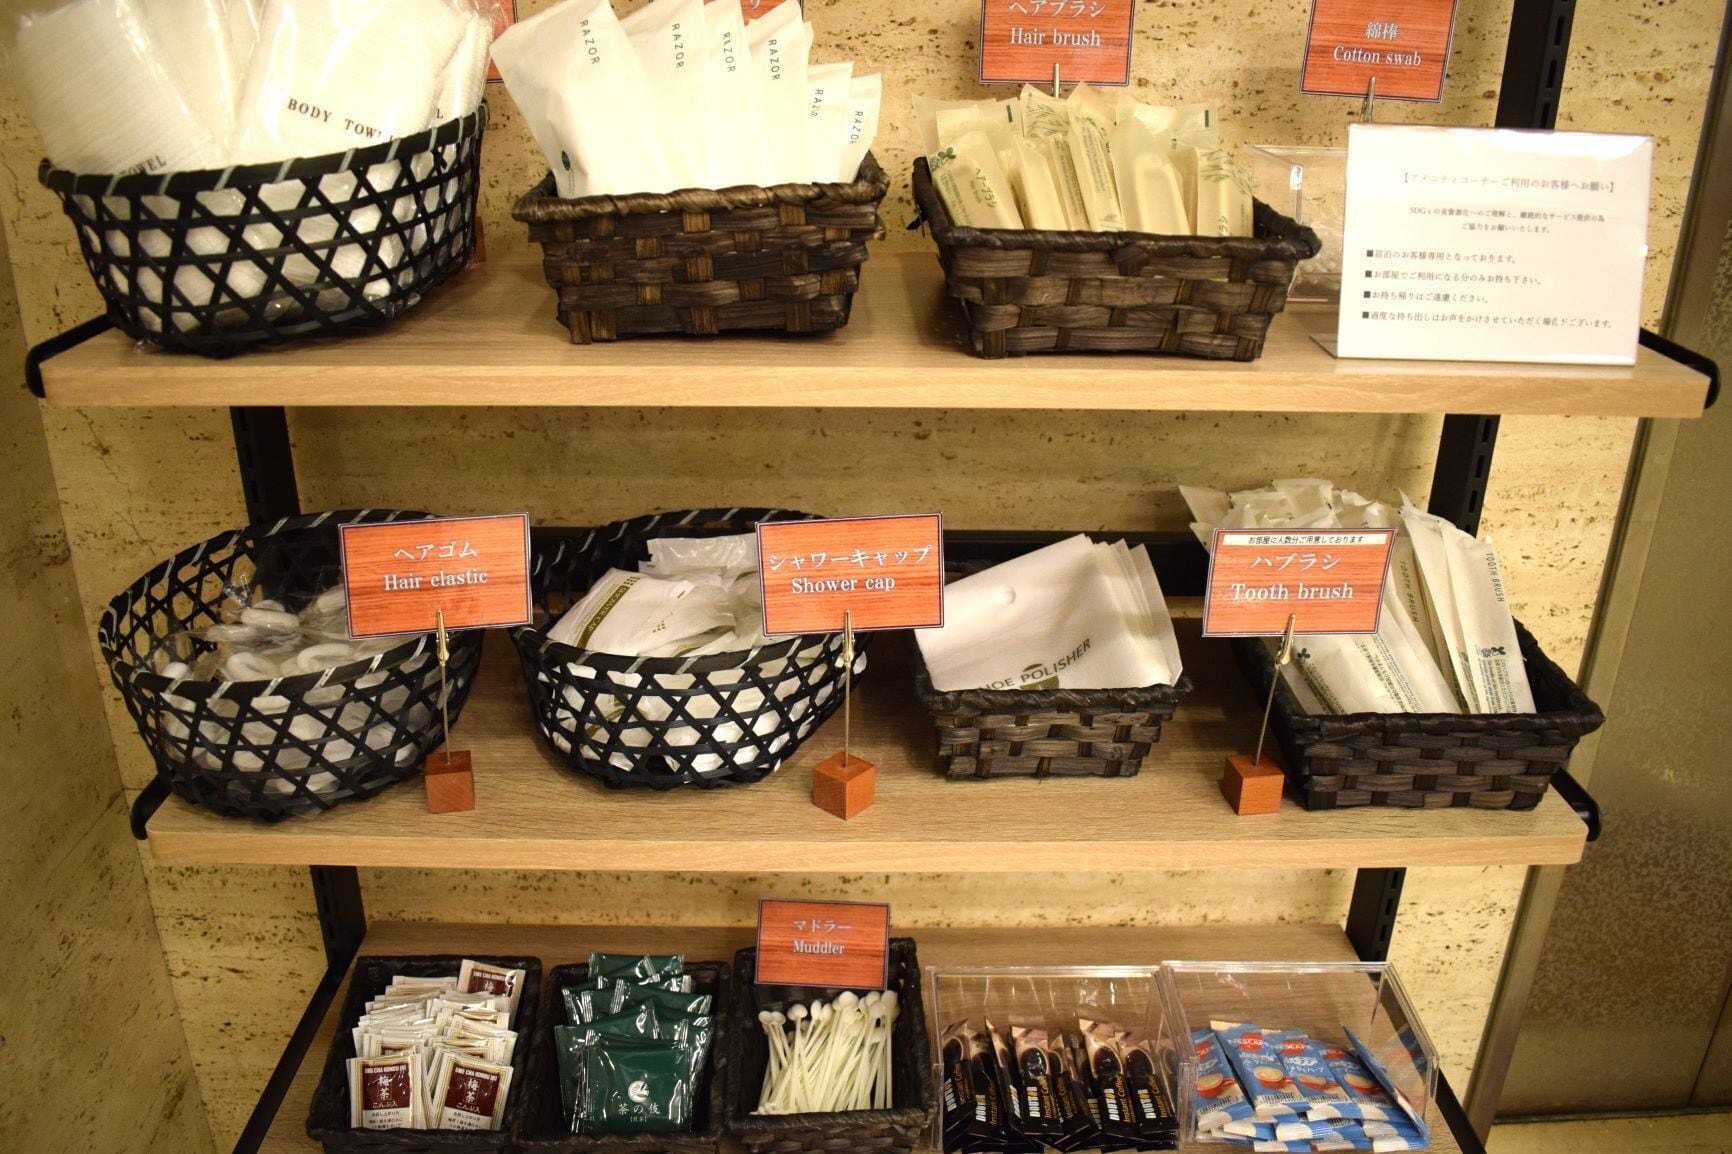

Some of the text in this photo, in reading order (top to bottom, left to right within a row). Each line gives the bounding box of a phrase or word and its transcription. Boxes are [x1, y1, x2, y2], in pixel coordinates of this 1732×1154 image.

[1008, 0, 1105, 17] ヘアブラシ
[579, 19, 600, 65] RAZOR
[1010, 27, 1101, 46] Hair brush
[1365, 21, 1398, 40] 綿棒
[671, 23, 685, 69] RAZOR
[1333, 45, 1422, 66] Cotton swab
[768, 39, 780, 81] RAZOR
[288, 97, 333, 123] BODY
[393, 540, 478, 560] ヘアゴム
[768, 544, 933, 571] シャワーキャップ
[1249, 553, 1343, 572] ハブラシ
[384, 569, 489, 591] Hair elastic
[792, 577, 896, 594] Shower cap
[1485, 552, 1505, 602] TOOTH BRUSH
[1231, 582, 1354, 602] Tooth brush
[1400, 560, 1420, 623] TOOTH BRUSH
[1020, 638, 1091, 683] POLISHER
[793, 919, 853, 933] マドラー
[792, 940, 846, 954] Muddler
[1026, 1086, 1041, 1118] DOUTOR
[1103, 1088, 1120, 1121] DOUTOR
[1137, 1088, 1157, 1119] DOUTOR
